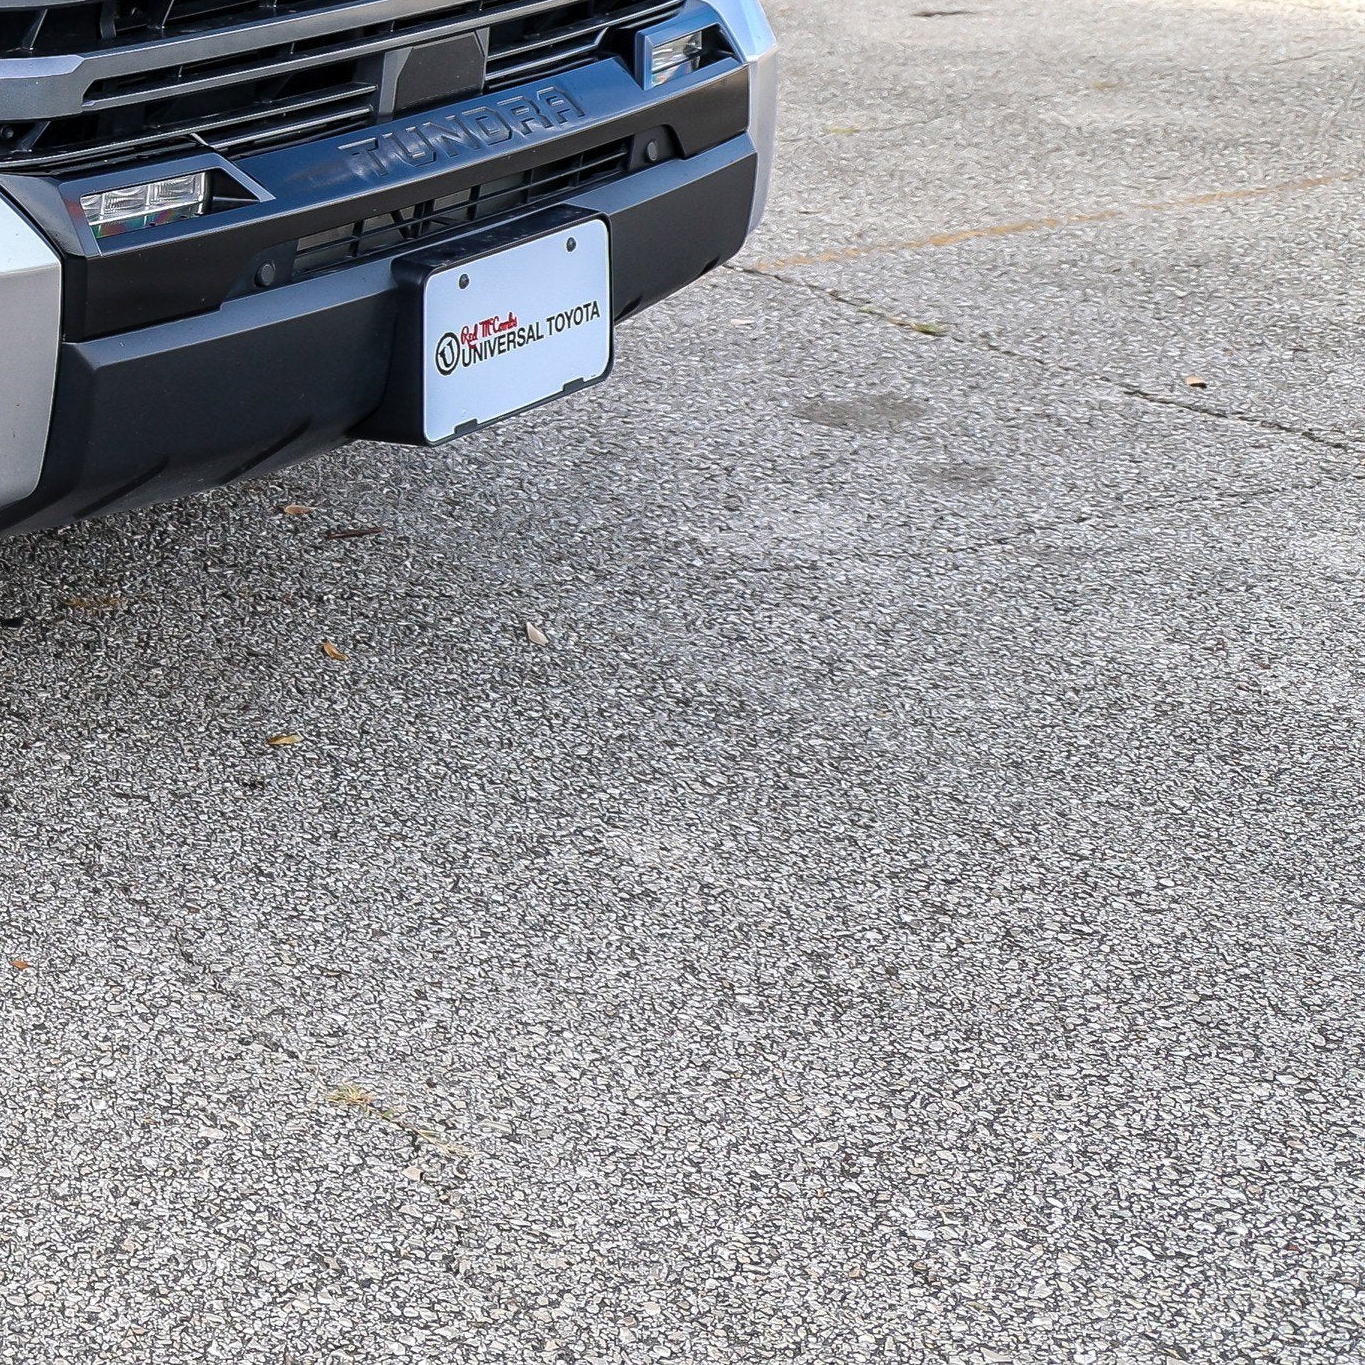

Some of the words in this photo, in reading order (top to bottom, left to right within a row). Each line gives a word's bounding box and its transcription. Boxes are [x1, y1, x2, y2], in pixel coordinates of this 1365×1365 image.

[337, 86, 586, 177] TUNDRA
[461, 322, 545, 367] UNIVERSAL
[546, 300, 601, 336] TOYOTA
